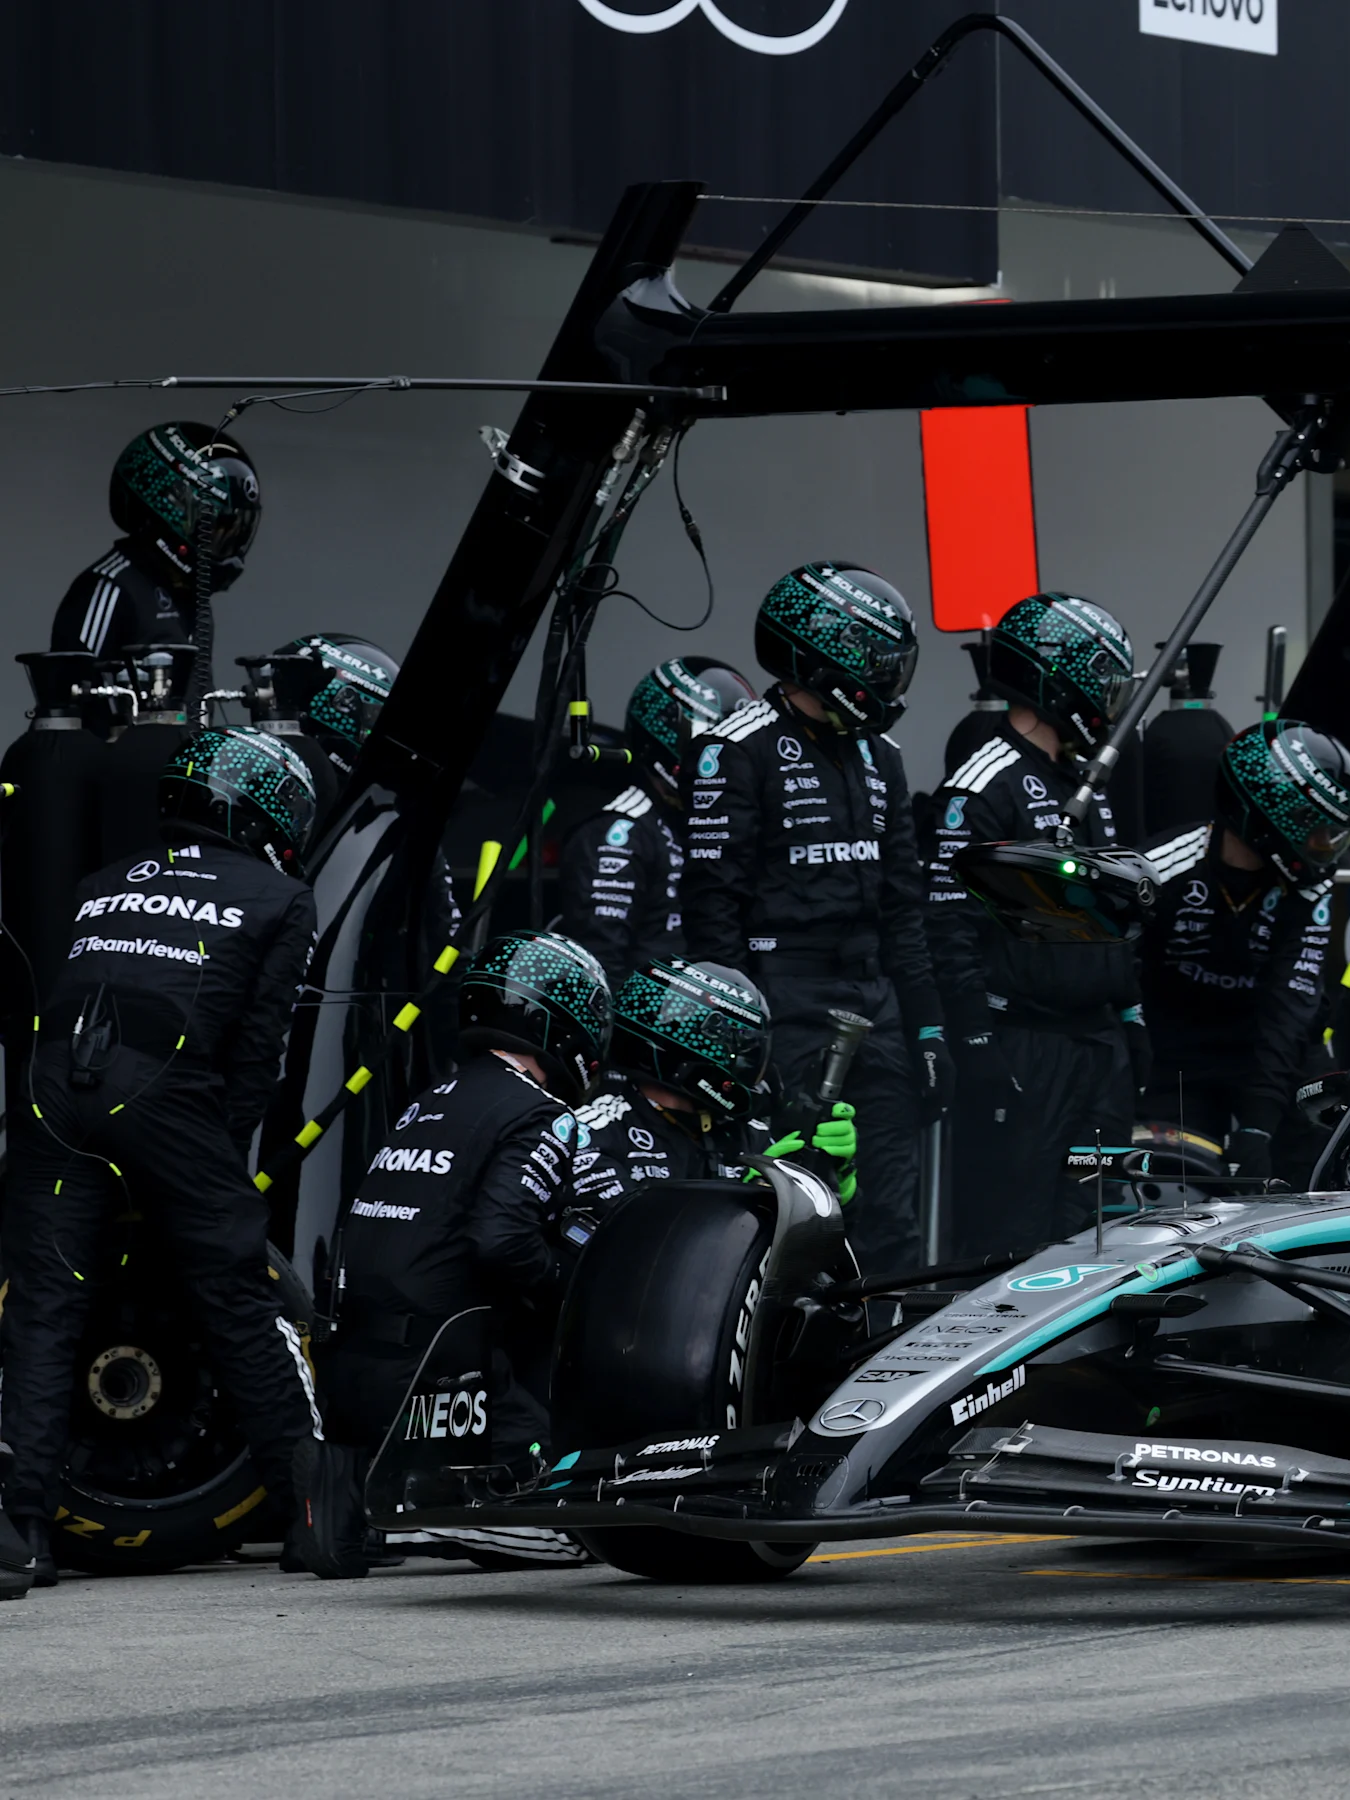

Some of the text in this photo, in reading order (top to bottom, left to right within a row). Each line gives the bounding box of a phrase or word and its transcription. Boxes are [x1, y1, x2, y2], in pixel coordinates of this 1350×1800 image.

[832, 575, 882, 611] SOLERA
[1297, 752, 1342, 796] SOLERA
[688, 816, 729, 826] Einhell
[74, 892, 244, 928] PETRONAS
[83, 936, 210, 966] TeamViewer
[652, 968, 704, 997] CROWDSTRIKE
[682, 965, 740, 999] SOLERA
[711, 995, 762, 1026] CROWDSTRIKE
[697, 1079, 735, 1111] Einhell
[1067, 1155, 1113, 1168] PETRONAS
[521, 1175, 551, 1203] nuvei
[919, 1324, 1008, 1335] INEOS
[944, 1312, 1029, 1320] CROWDSTRIKE
[874, 1354, 962, 1363] AKKODIS
[861, 1370, 911, 1382] SAP
[950, 1363, 1027, 1426] Einhell
[404, 1390, 487, 1440] INEOS
[636, 1434, 721, 1457] PETRONAS
[1134, 1443, 1276, 1468] PETRONAS
[1131, 1469, 1276, 1498] Syntium
[113, 1529, 153, 1547] P
